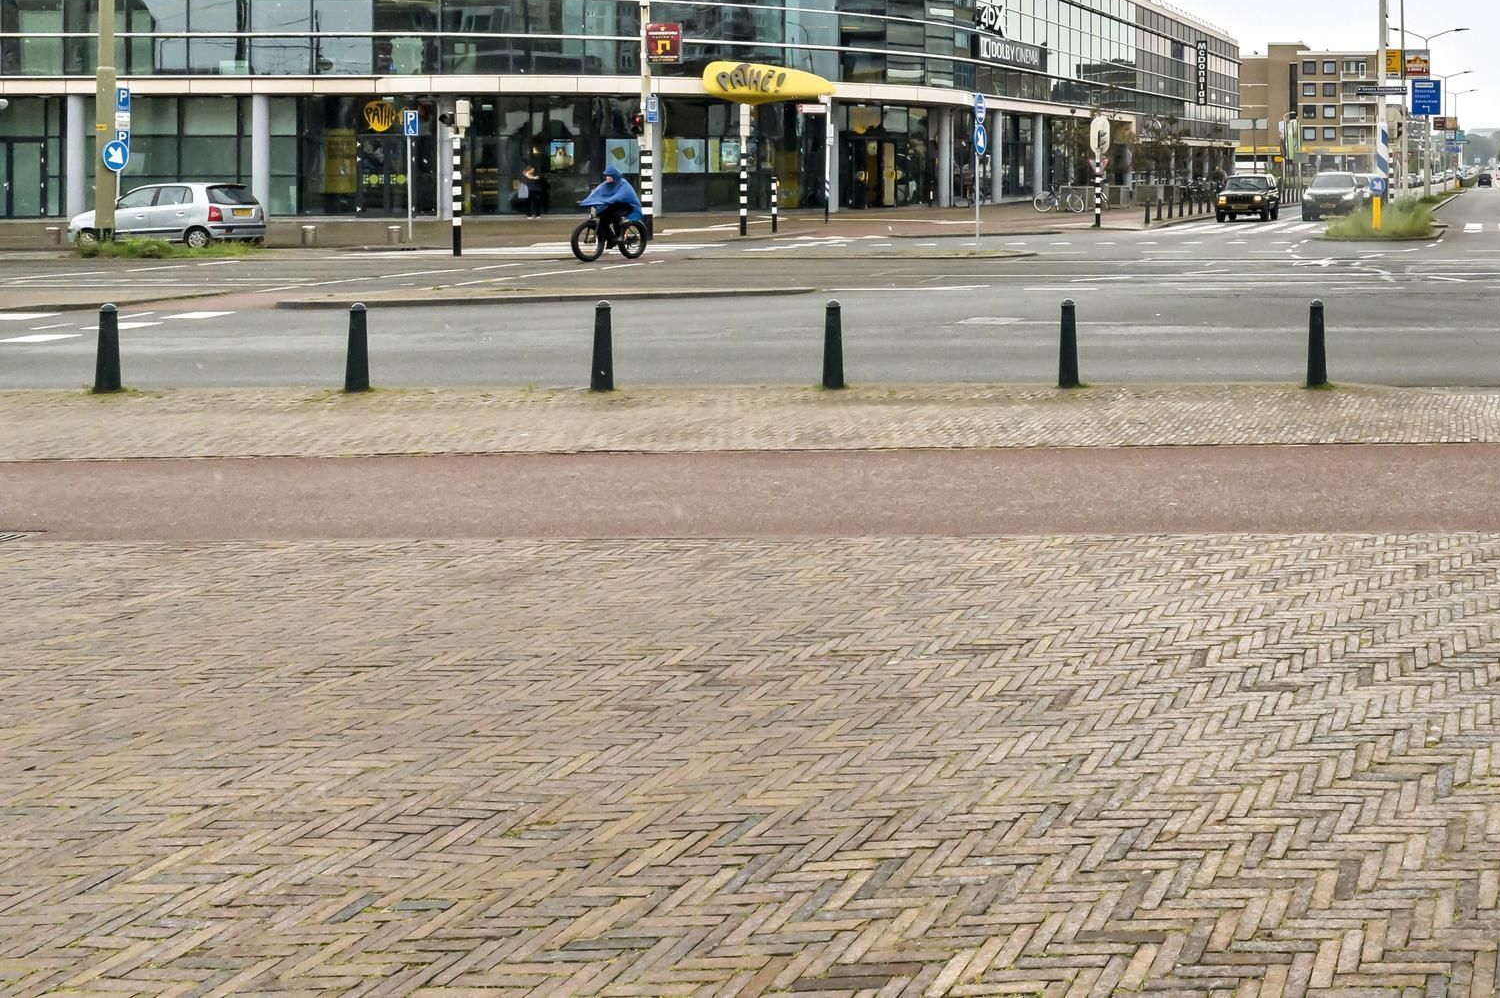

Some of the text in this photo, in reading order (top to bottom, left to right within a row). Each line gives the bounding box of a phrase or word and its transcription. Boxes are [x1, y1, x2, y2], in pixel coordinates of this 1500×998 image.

[980, 4, 1008, 39] 4DX
[991, 41, 1040, 66] DOLBY CINEMA
[120, 90, 128, 102] P
[407, 112, 416, 125] P
